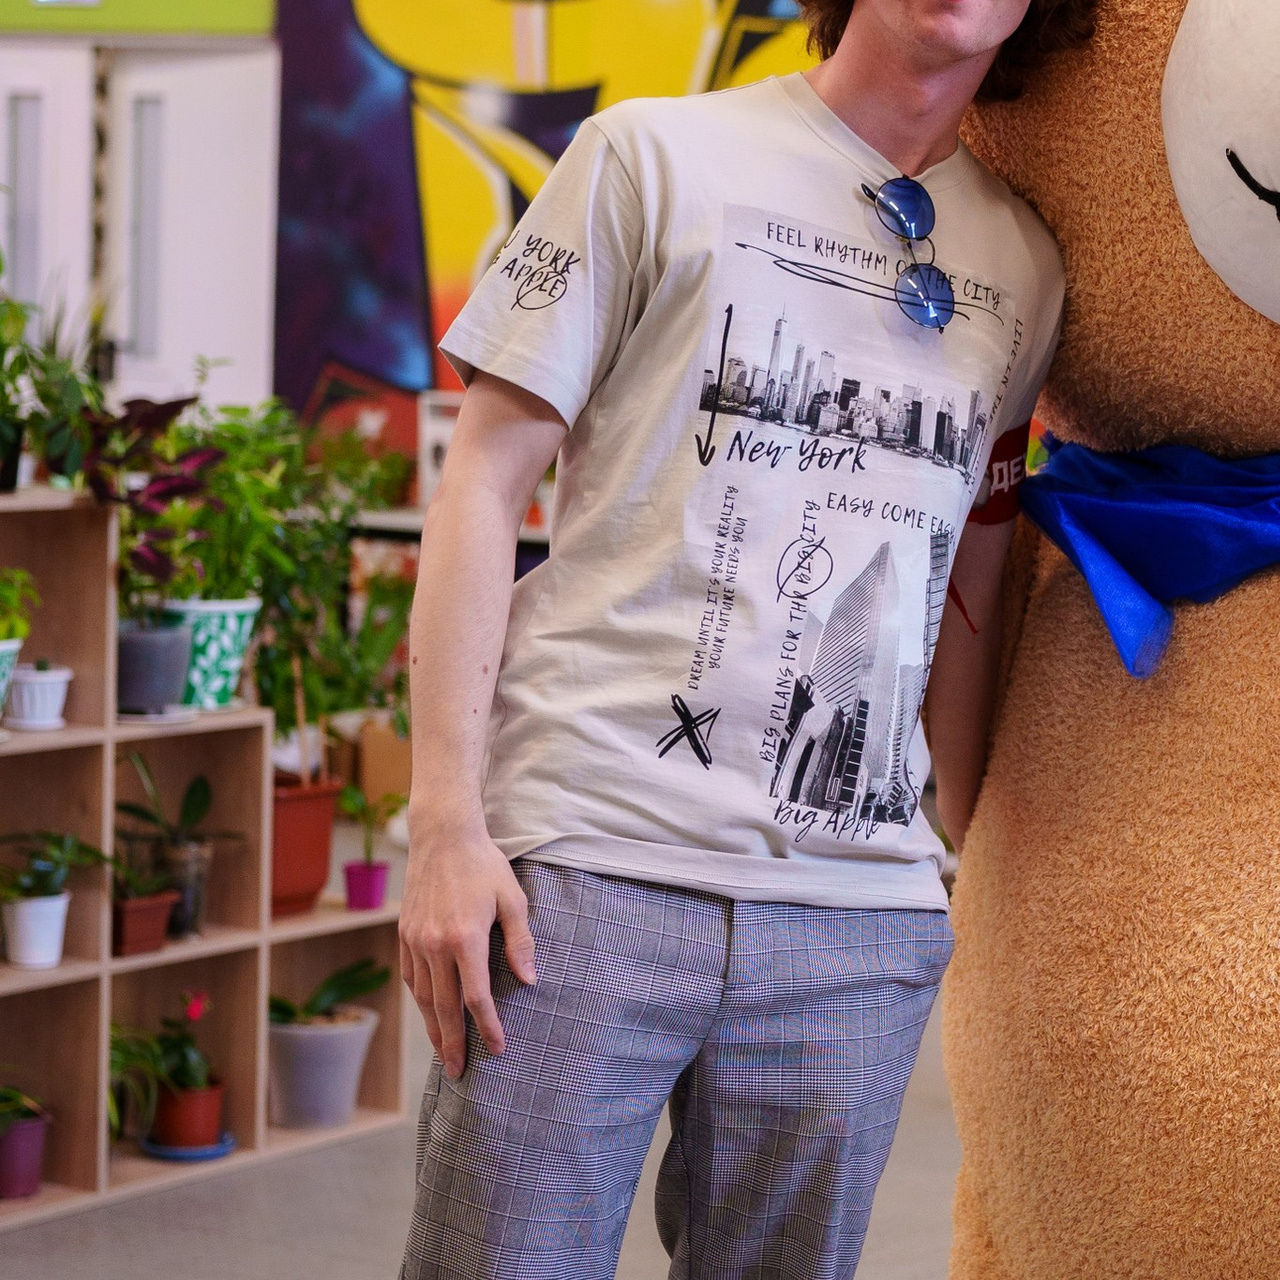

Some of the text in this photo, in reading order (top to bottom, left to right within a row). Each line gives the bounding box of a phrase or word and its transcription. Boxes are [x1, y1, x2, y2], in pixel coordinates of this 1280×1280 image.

[522, 233, 581, 275] YORK
[766, 221, 806, 248] FEEL
[813, 236, 887, 276] RHYTHM
[924, 267, 957, 293] THE
[963, 278, 1001, 310] CITY
[500, 257, 565, 298] APPLE
[1010, 318, 1024, 361] LIVE
[726, 430, 867, 473] New York
[799, 499, 821, 544] CITY
[826, 491, 875, 514] EASY
[881, 501, 927, 530] COME
[687, 484, 739, 691] DREAM UNTIL IT'S YOUR REALITY
[795, 548, 814, 586] BIG
[708, 516, 749, 670] YOUR FUTURE NEEDS YOU
[780, 628, 802, 662] FOR
[769, 665, 795, 723] PLANS
[759, 725, 781, 764] BIG
[773, 799, 881, 843] Big Apple
